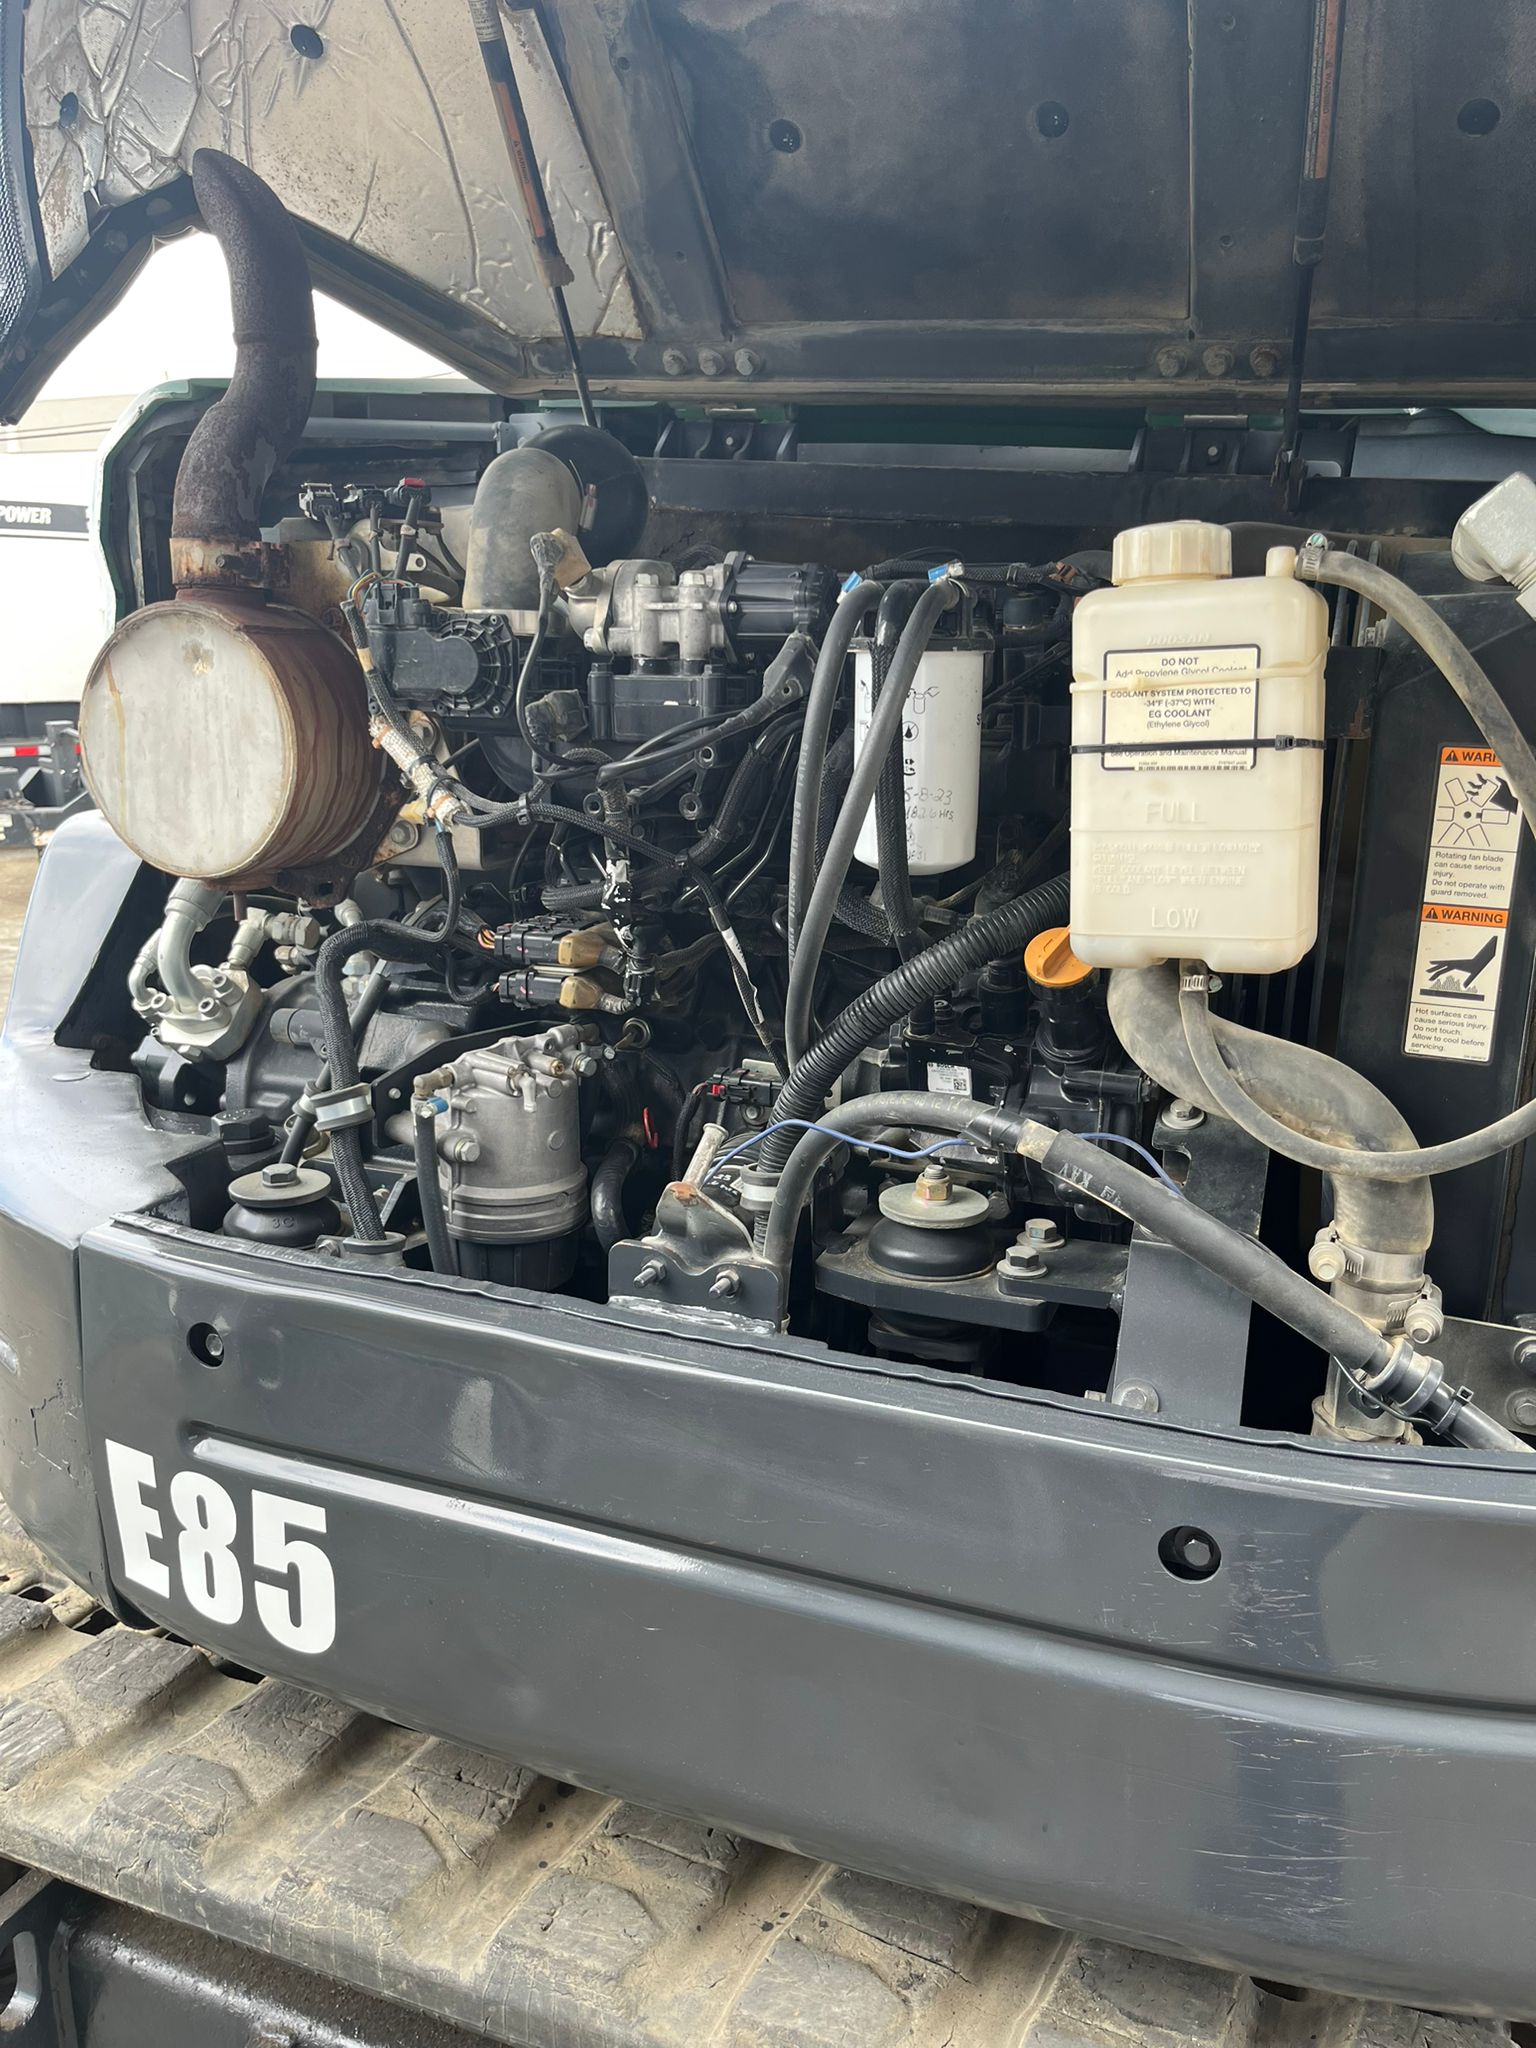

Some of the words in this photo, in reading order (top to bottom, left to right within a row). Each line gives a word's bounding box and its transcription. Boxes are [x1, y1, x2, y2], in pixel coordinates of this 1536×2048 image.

[1161, 658, 1175, 666] DO
[1178, 657, 1199, 666] NOT
[1110, 690, 1148, 698] COOLANT
[1150, 689, 1184, 698] SYSTEM
[1186, 688, 1237, 696] PROTECTED
[1194, 698, 1215, 706] WITH
[1148, 710, 1161, 718] EG
[1164, 709, 1211, 718] COOLANT
[1146, 721, 1181, 730] (Ethylene
[1183, 720, 1210, 729] Glycol)
[1174, 748, 1219, 756] Maintenance
[1221, 748, 1247, 756] Manual
[1146, 800, 1208, 824] FULL
[1435, 851, 1467, 861] Rotating
[1482, 854, 1504, 862] blade
[1474, 864, 1502, 872] serious
[1432, 870, 1455, 879] injury.
[1458, 882, 1488, 890] operate
[1430, 888, 1452, 896] guard
[1454, 890, 1488, 899] removed.
[1151, 906, 1200, 929] LOW
[1441, 910, 1503, 924] WARNING
[1430, 1009, 1462, 1018] surfaces
[1438, 1019, 1464, 1028] serious
[1466, 1021, 1489, 1030] injury.
[1440, 1027, 1462, 1036] touch.
[1412, 1033, 1432, 1041] Allow
[1460, 1038, 1485, 1046] before
[105, 1438, 336, 1654] E85
